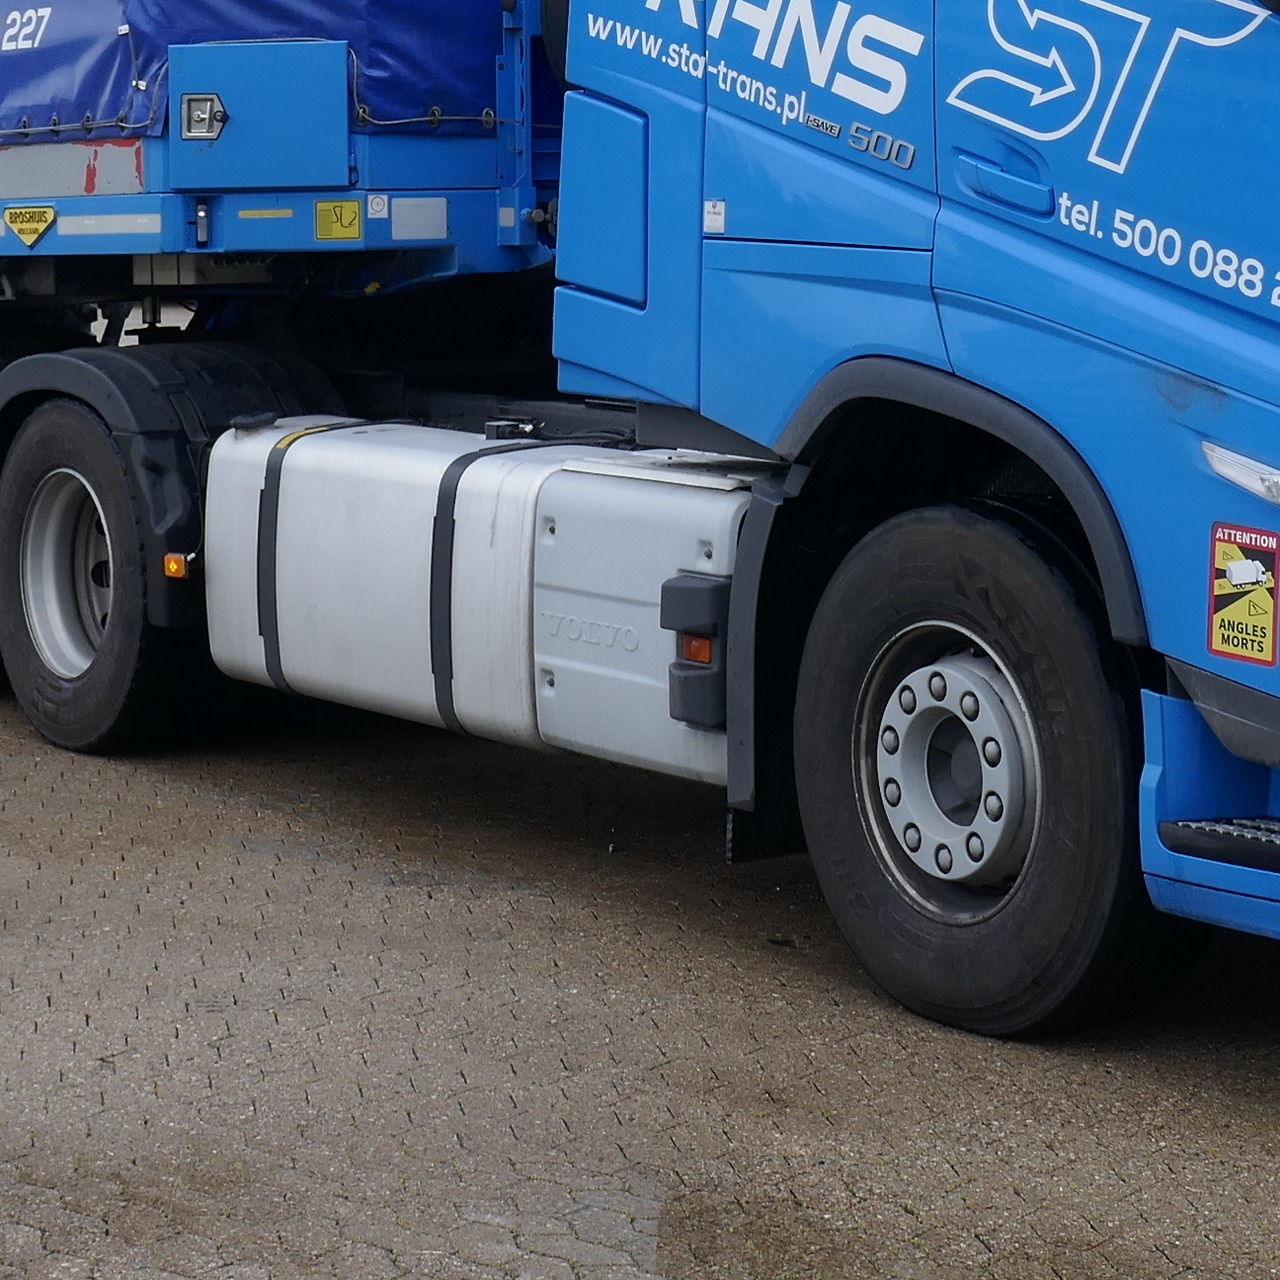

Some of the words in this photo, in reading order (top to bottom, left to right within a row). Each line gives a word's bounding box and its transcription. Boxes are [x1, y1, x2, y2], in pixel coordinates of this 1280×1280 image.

[1, 7, 51, 51] 227
[847, 122, 915, 169] 500
[1058, 191, 1104, 241] tel.
[1112, 209, 1182, 268] 500
[1188, 237, 1264, 299] 088
[1216, 528, 1277, 549] ATTENTION
[1219, 618, 1267, 639] ANGLES
[1221, 632, 1264, 653] MORTS
